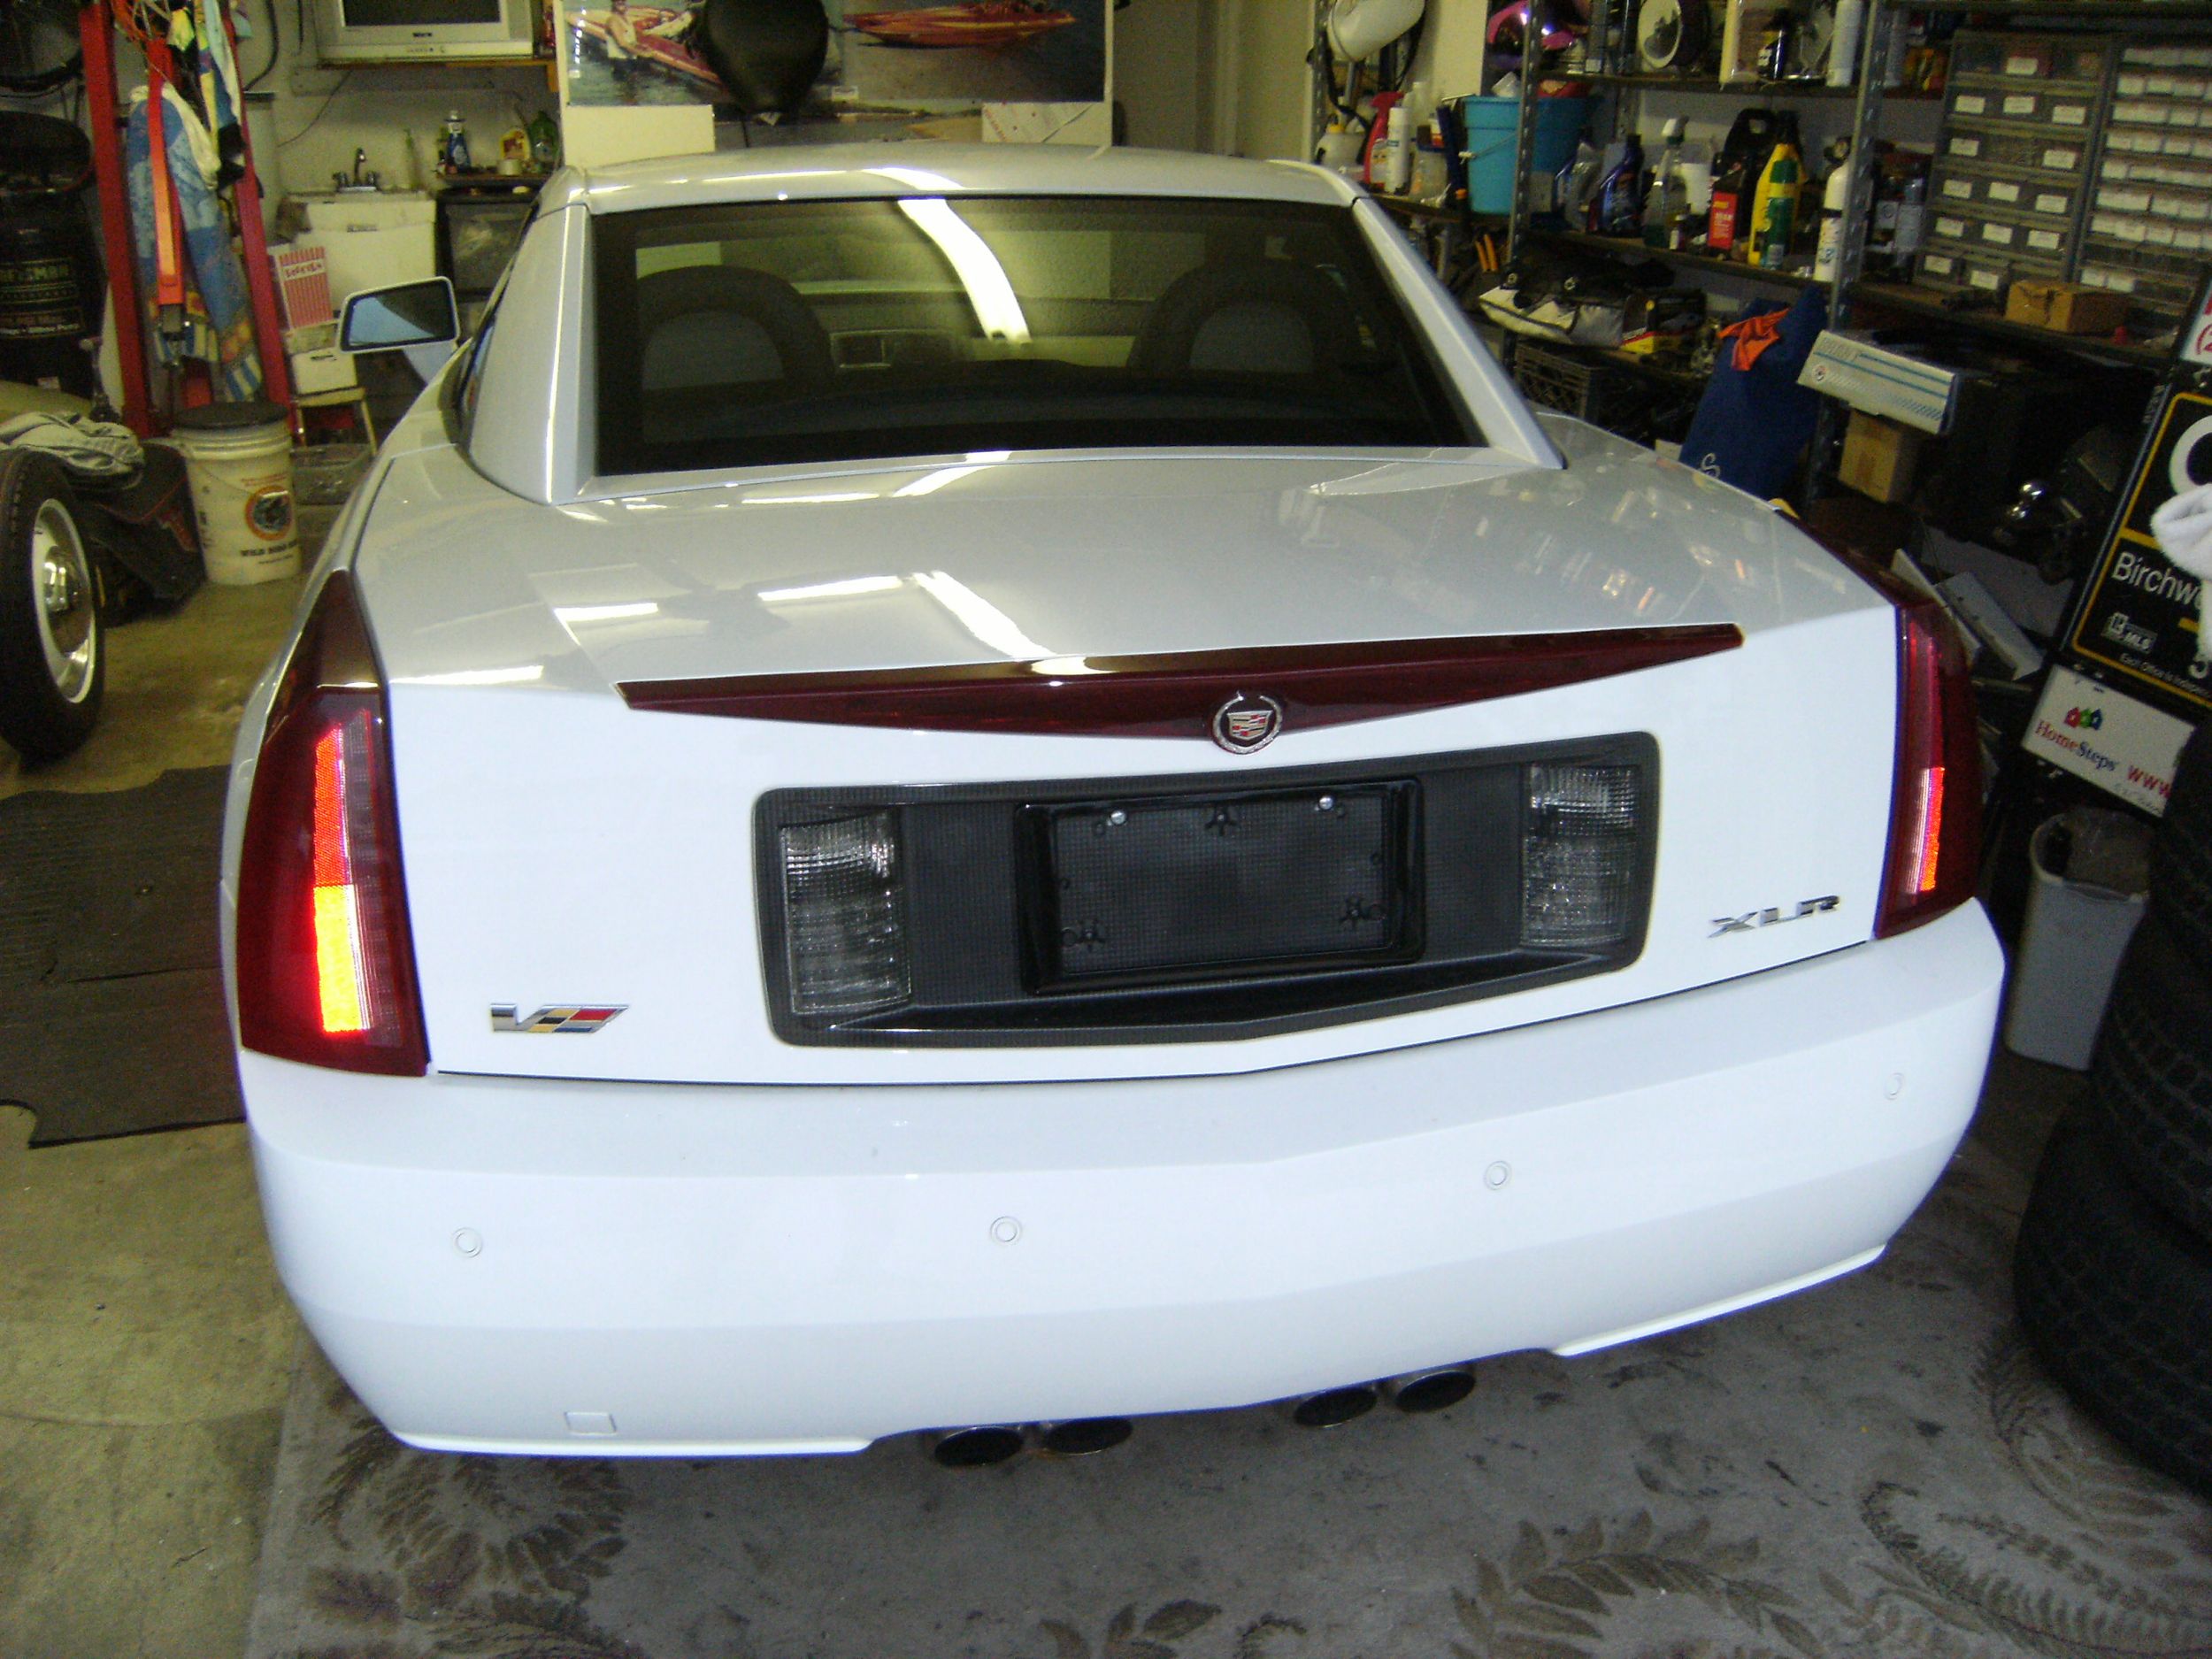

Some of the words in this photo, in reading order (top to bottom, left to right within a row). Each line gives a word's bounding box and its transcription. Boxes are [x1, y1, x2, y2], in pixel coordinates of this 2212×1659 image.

[2111, 551, 2201, 609] Birchw
[2035, 720, 2116, 772] HomeSteps
[1707, 895, 1840, 938] XLR
